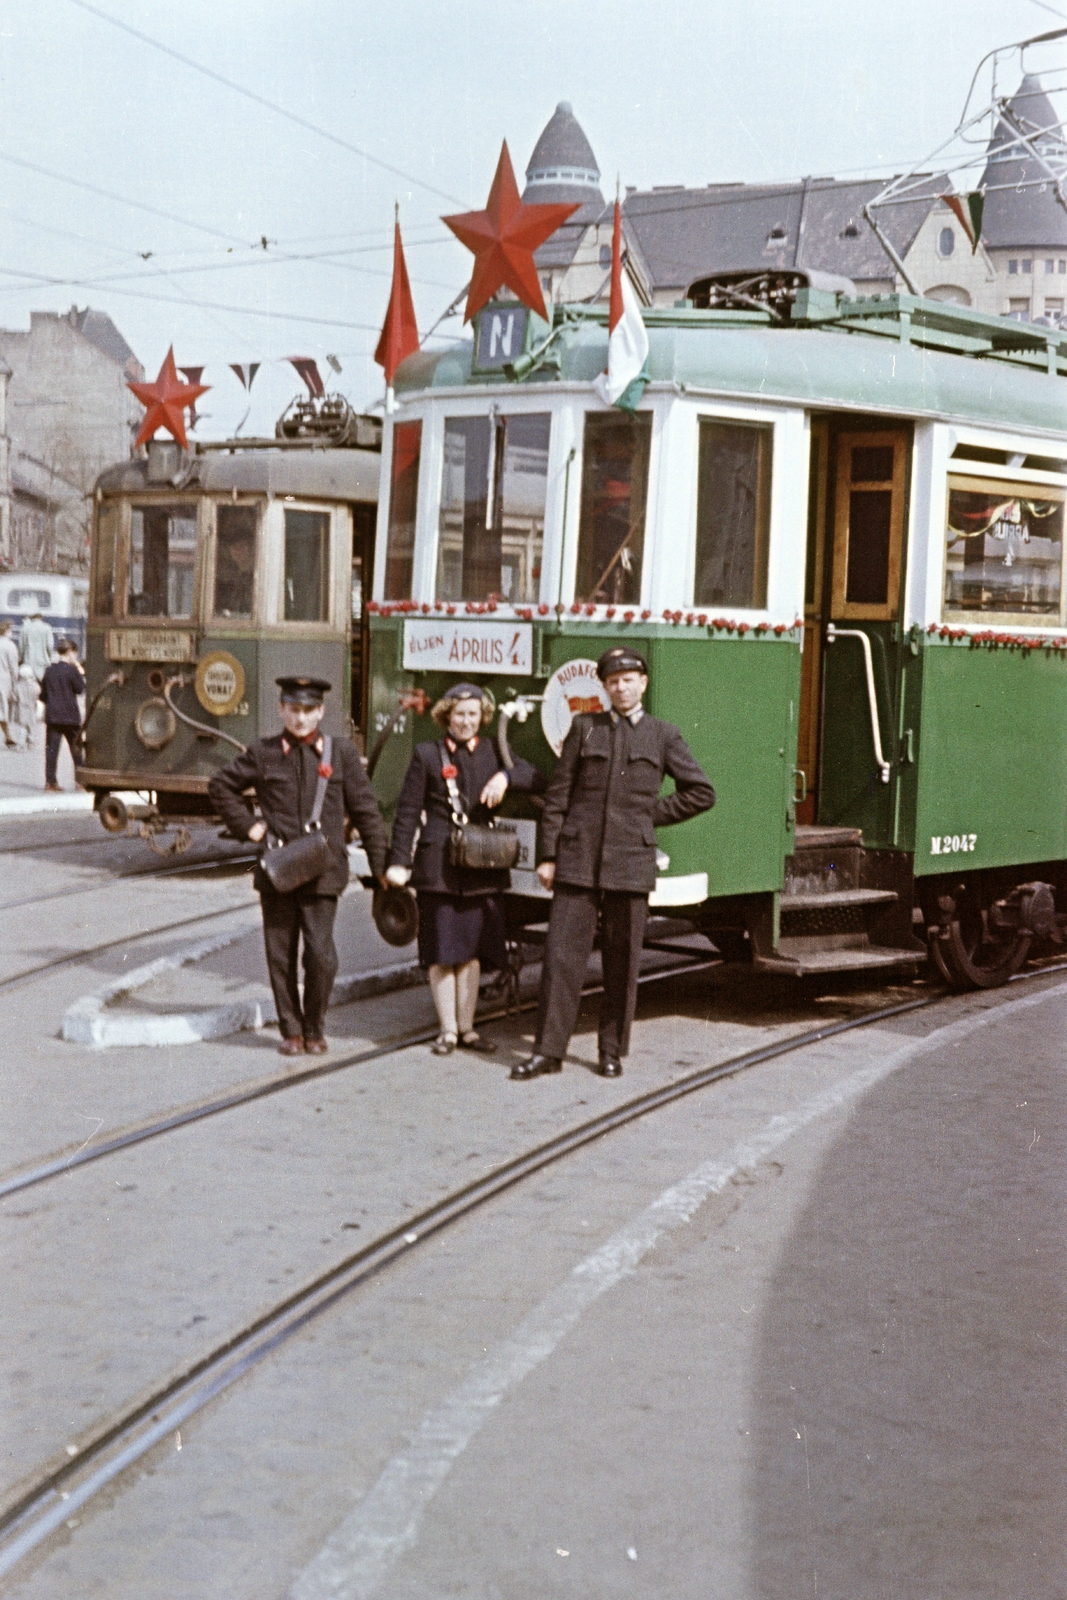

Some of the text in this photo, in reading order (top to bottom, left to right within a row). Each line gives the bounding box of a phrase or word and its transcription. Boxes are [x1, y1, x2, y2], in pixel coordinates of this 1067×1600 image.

[490, 314, 514, 358] N
[409, 634, 444, 653] ÉLJEN
[448, 629, 503, 664] ÁPRILIS
